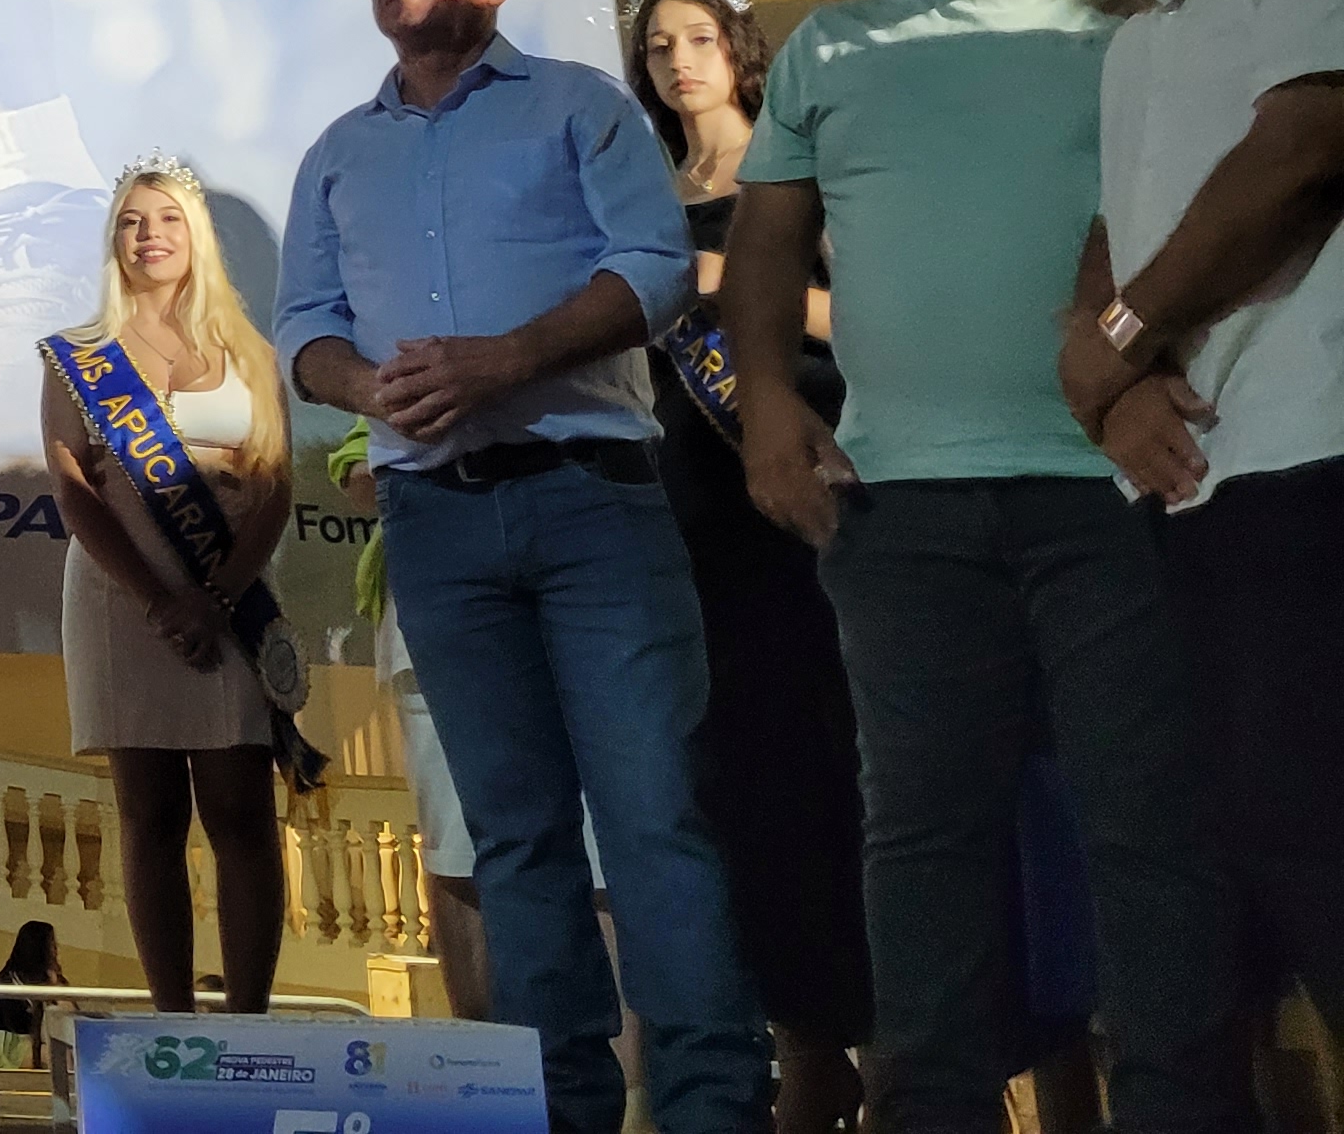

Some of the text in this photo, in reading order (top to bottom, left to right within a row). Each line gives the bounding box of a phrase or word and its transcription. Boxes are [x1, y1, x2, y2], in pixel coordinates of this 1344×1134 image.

[217, 1068, 313, 1082] 28 de JANEIRO
